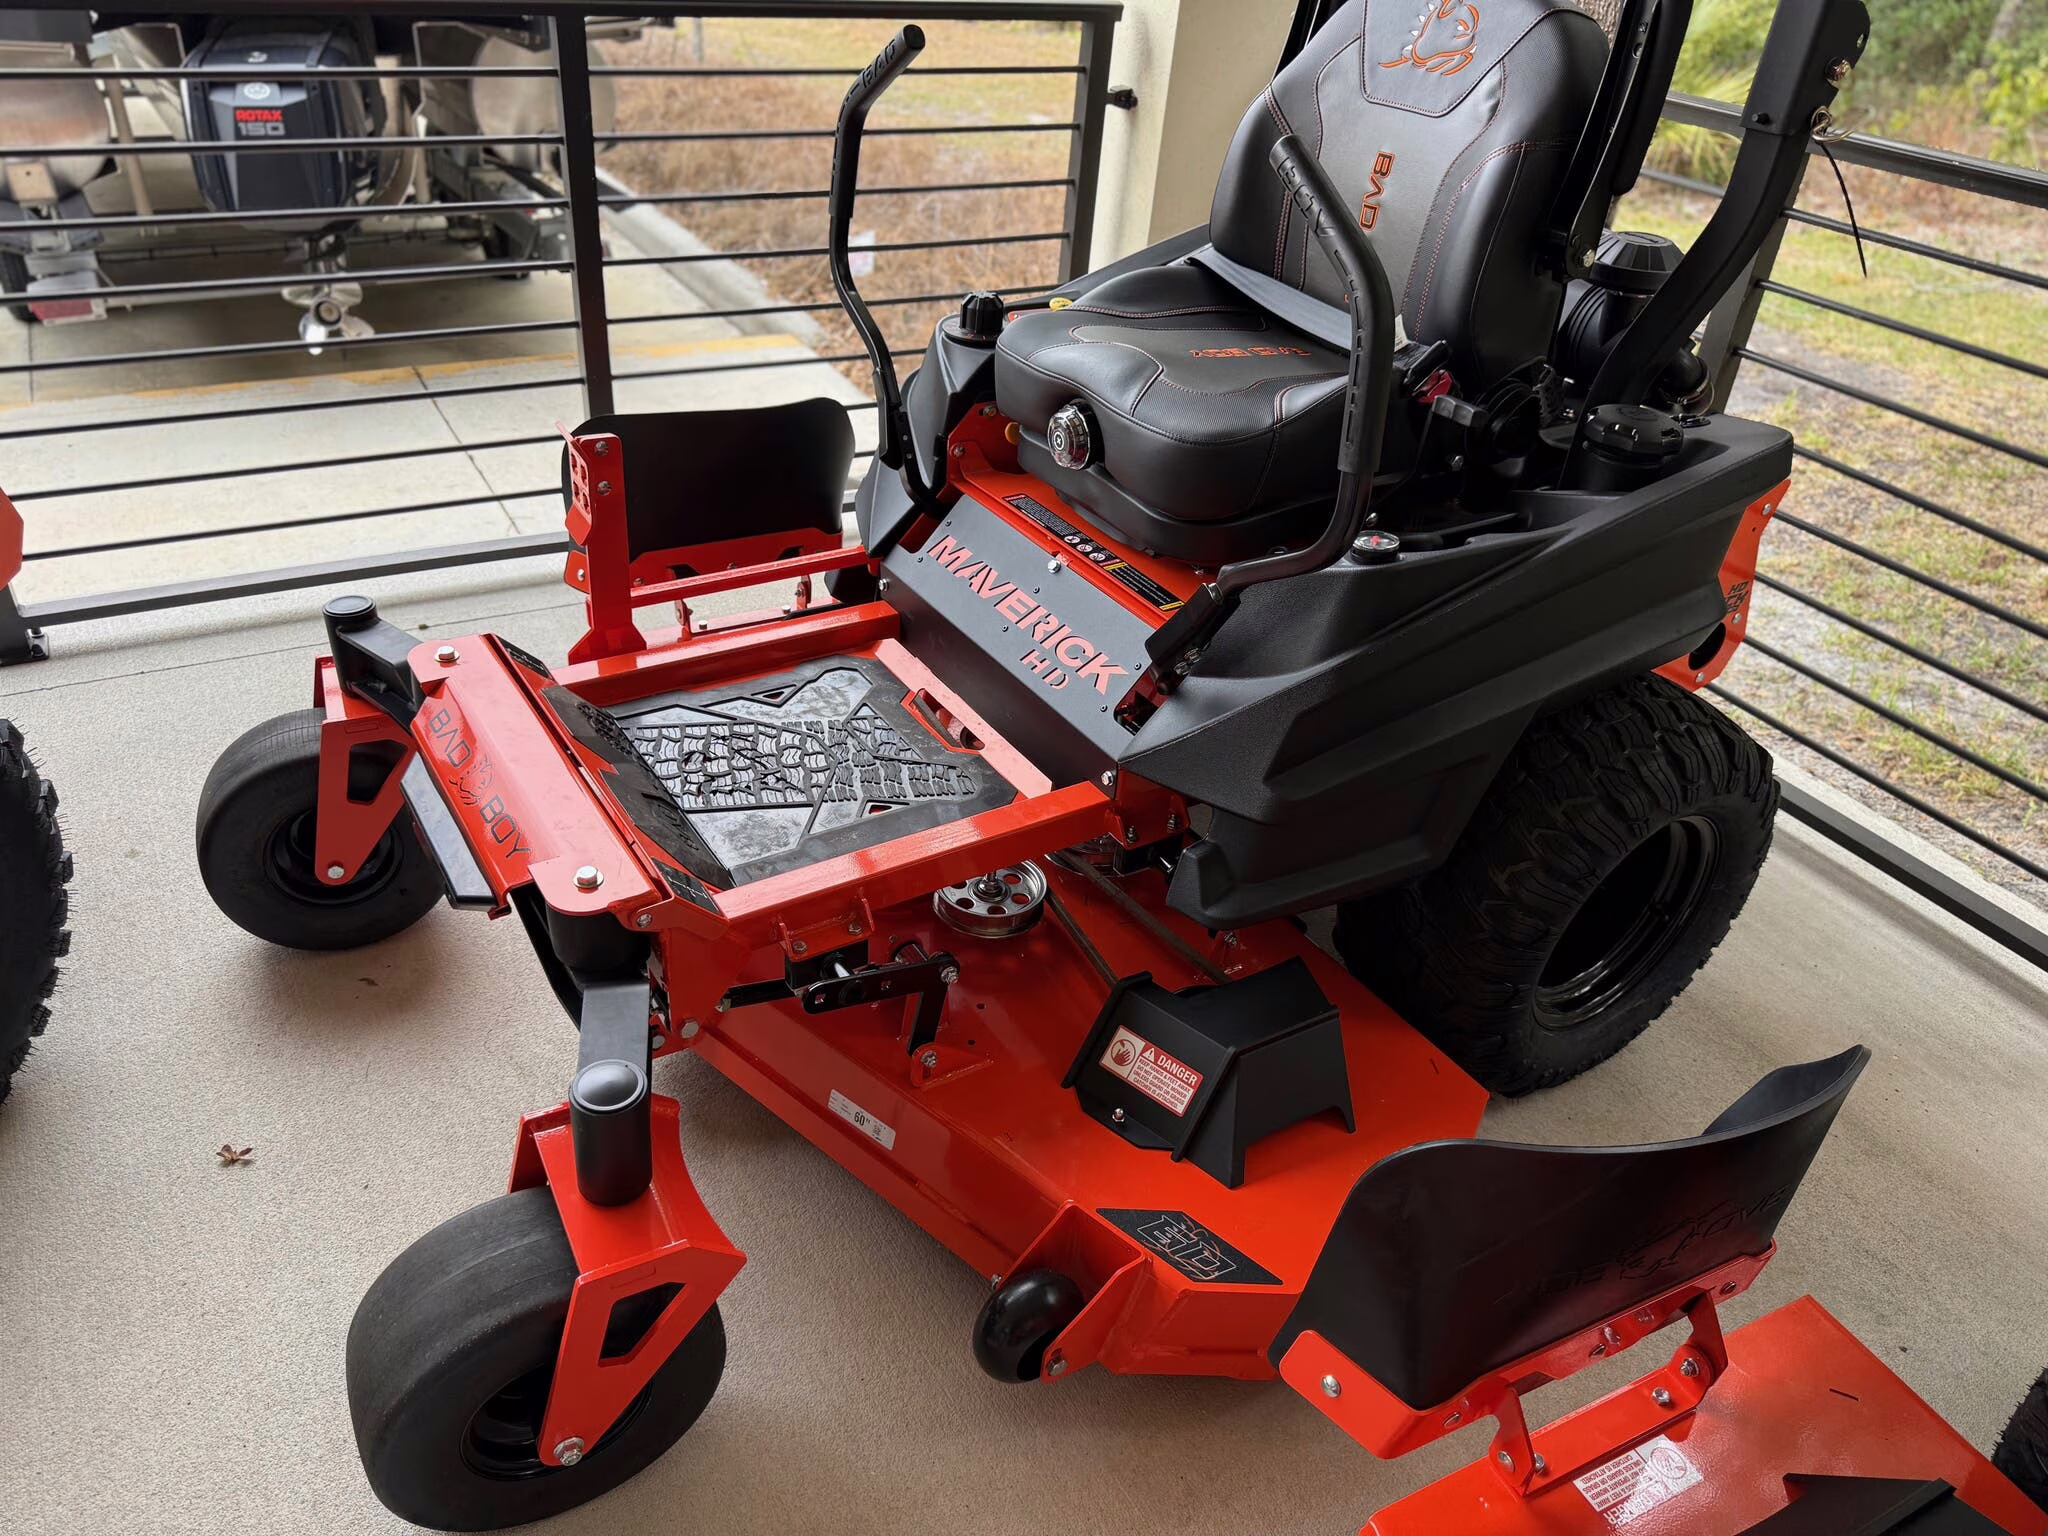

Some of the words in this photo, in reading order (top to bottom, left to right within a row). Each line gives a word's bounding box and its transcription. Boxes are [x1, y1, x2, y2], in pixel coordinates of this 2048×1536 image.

[235, 109, 284, 122] ROTAX
[238, 122, 285, 136] 150
[1360, 151, 1395, 232] BAD
[927, 535, 1129, 696] MAVERICK
[1020, 649, 1069, 690] HD
[429, 708, 471, 768] BAD
[479, 794, 532, 859] BOY
[1156, 1054, 1198, 1086] DANGER
[1132, 1076, 1151, 1091] CATCHER
[1143, 1068, 1154, 1078] NOT
[1153, 1075, 1170, 1088] OPERATE
[1169, 1085, 1187, 1099] MOWER
[1148, 1079, 1163, 1092] GUARD
[1609, 1453, 1633, 1469] CATCHER
[1622, 1458, 1642, 1472] UNLESS
[1598, 1477, 1609, 1485] OR
[1606, 1468, 1625, 1481] GUARD
[1627, 1469, 1640, 1479] NOT
[1581, 1481, 1601, 1495] GRASS
[1606, 1474, 1631, 1491] OPERATE
[1588, 1486, 1610, 1501] MOWER
[1608, 1490, 1623, 1501] FEET
